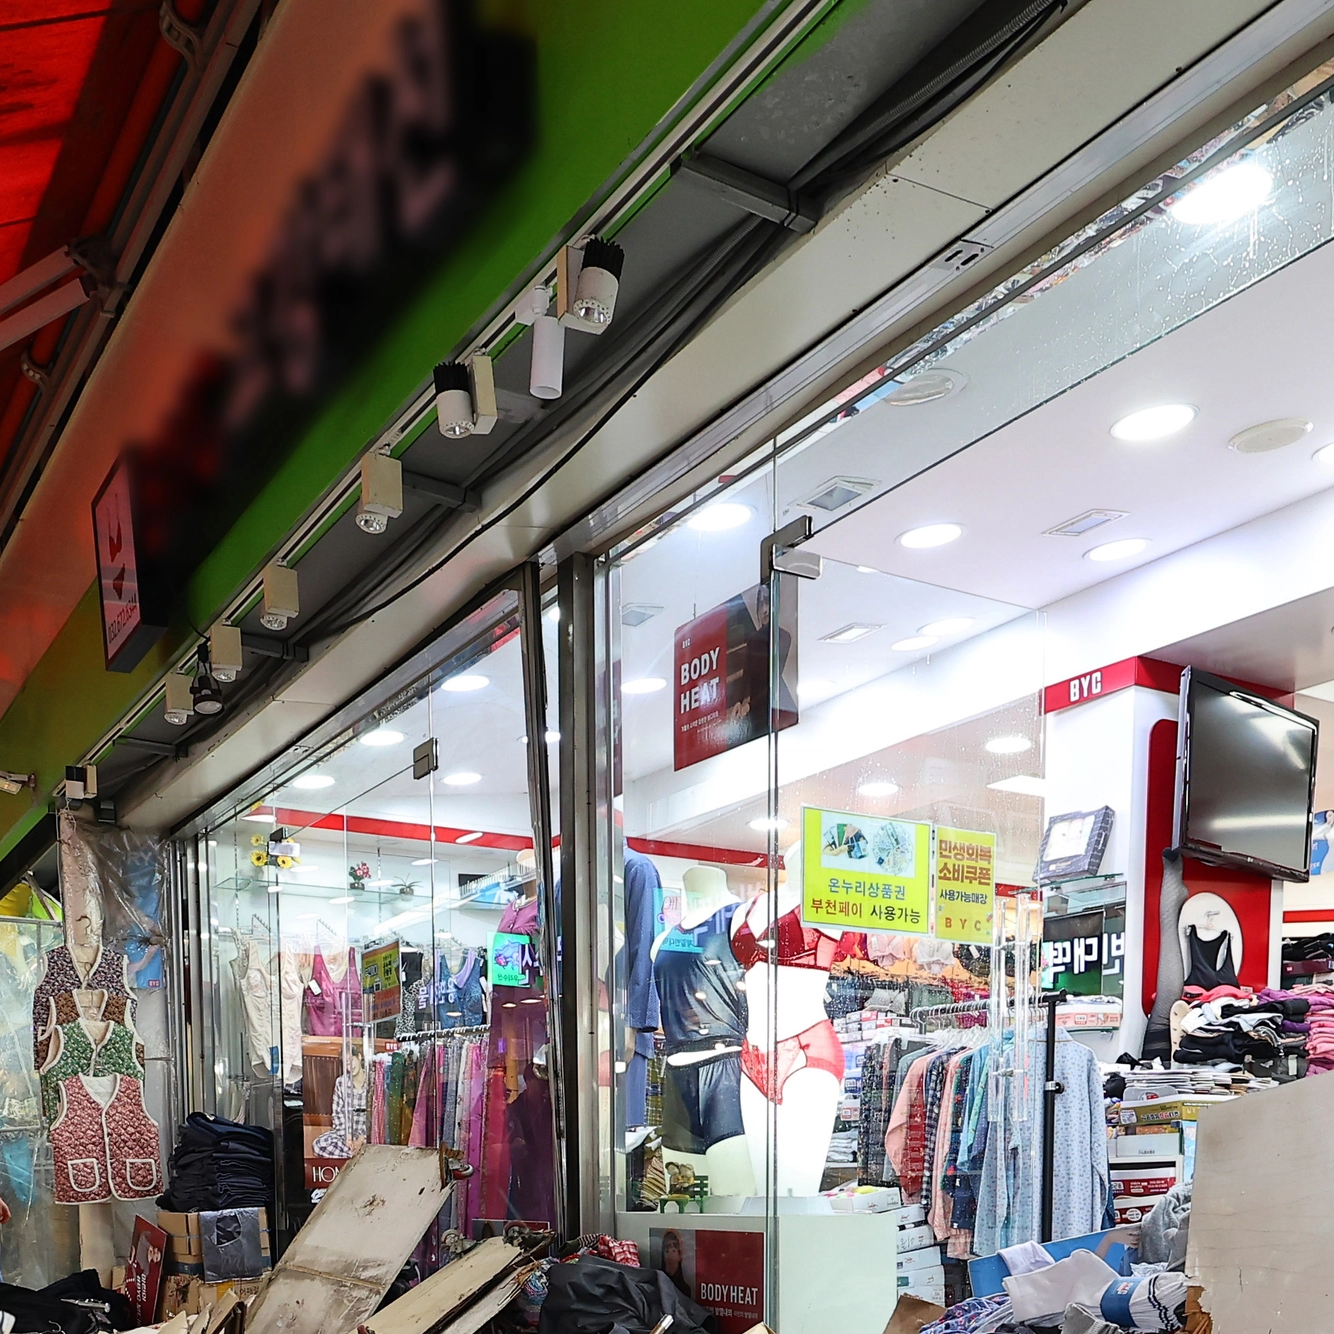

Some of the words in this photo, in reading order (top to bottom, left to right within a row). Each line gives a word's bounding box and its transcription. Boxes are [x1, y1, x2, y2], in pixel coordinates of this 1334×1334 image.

[680, 647, 720, 686] BODY
[680, 677, 720, 714] HEAT
[1069, 671, 1102, 702] BYC
[939, 839, 992, 865] 민생회복
[938, 862, 992, 886] 소비쿠폰
[828, 878, 906, 901] 온누리상품권
[939, 889, 988, 905] 사용가능매장
[810, 898, 863, 919] 부천페이
[870, 905, 921, 924] 사용가능
[700, 1283, 728, 1302] BODY
[730, 1285, 758, 1305] HEAT
